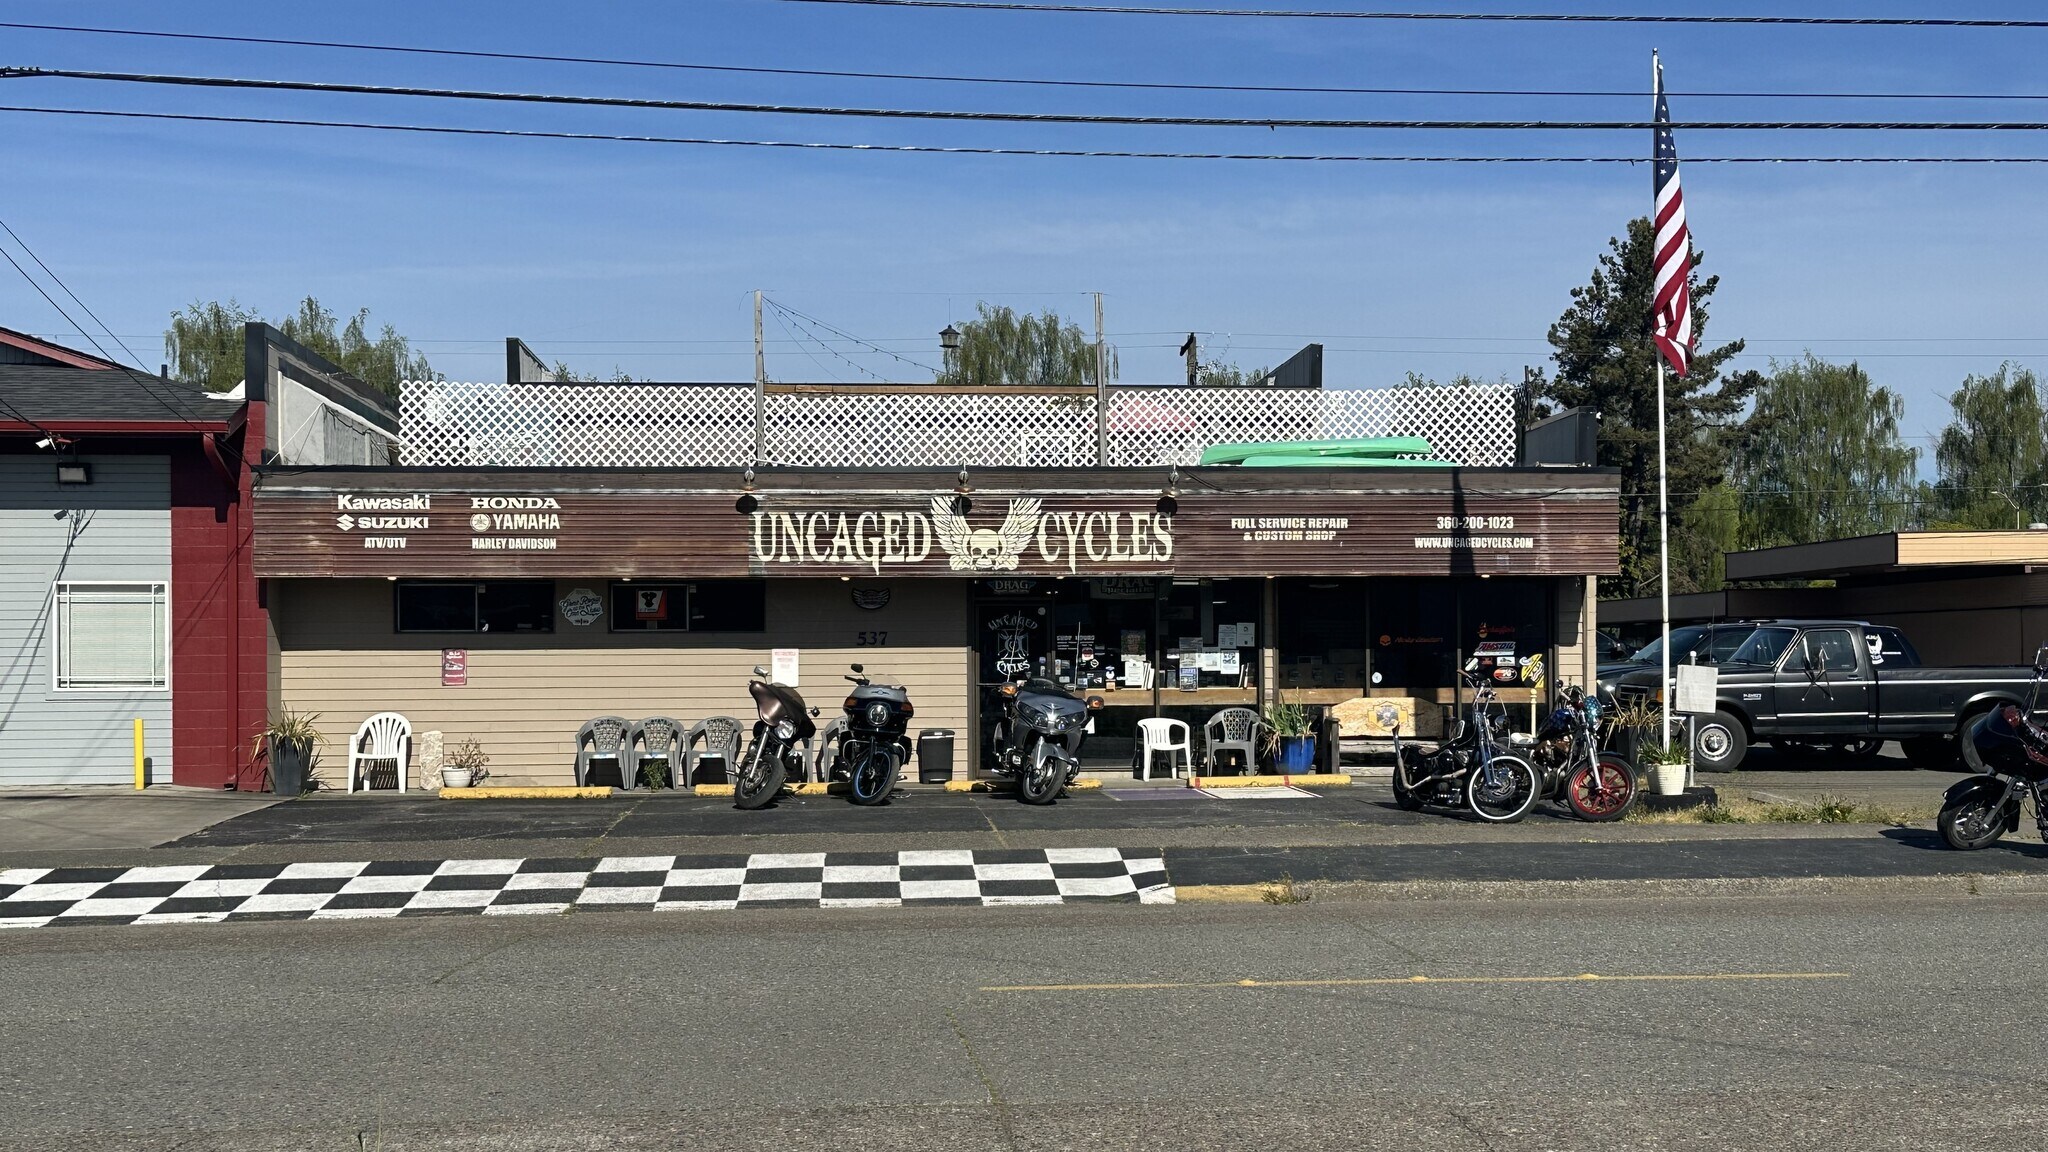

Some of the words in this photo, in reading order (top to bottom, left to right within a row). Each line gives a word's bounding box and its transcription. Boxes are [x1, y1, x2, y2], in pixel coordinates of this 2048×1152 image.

[338, 494, 430, 510] Kawasaki
[471, 497, 561, 509] HONDA
[358, 517, 429, 529] SUZUKI
[493, 514, 560, 530] YAMAHA
[1231, 518, 1256, 529] FULL
[1258, 518, 1306, 529] SERVICE
[1308, 518, 1348, 529] REPAIR
[1437, 516, 1514, 529] 360-200-1023
[1243, 531, 1252, 541] &
[1254, 531, 1303, 541] CUSTOM
[1305, 531, 1336, 541] SHOP
[364, 537, 407, 548] ATV/UTV
[472, 538, 507, 549] HARLEY
[509, 538, 557, 549] DAVIDSON
[752, 512, 931, 575] UNCAGED
[1036, 512, 1173, 574] CYCLES
[1414, 537, 1534, 549] WWW.UNCAGEDCYCLES.COM
[995, 580, 1028, 590] DRAG
[857, 631, 888, 646] 537
